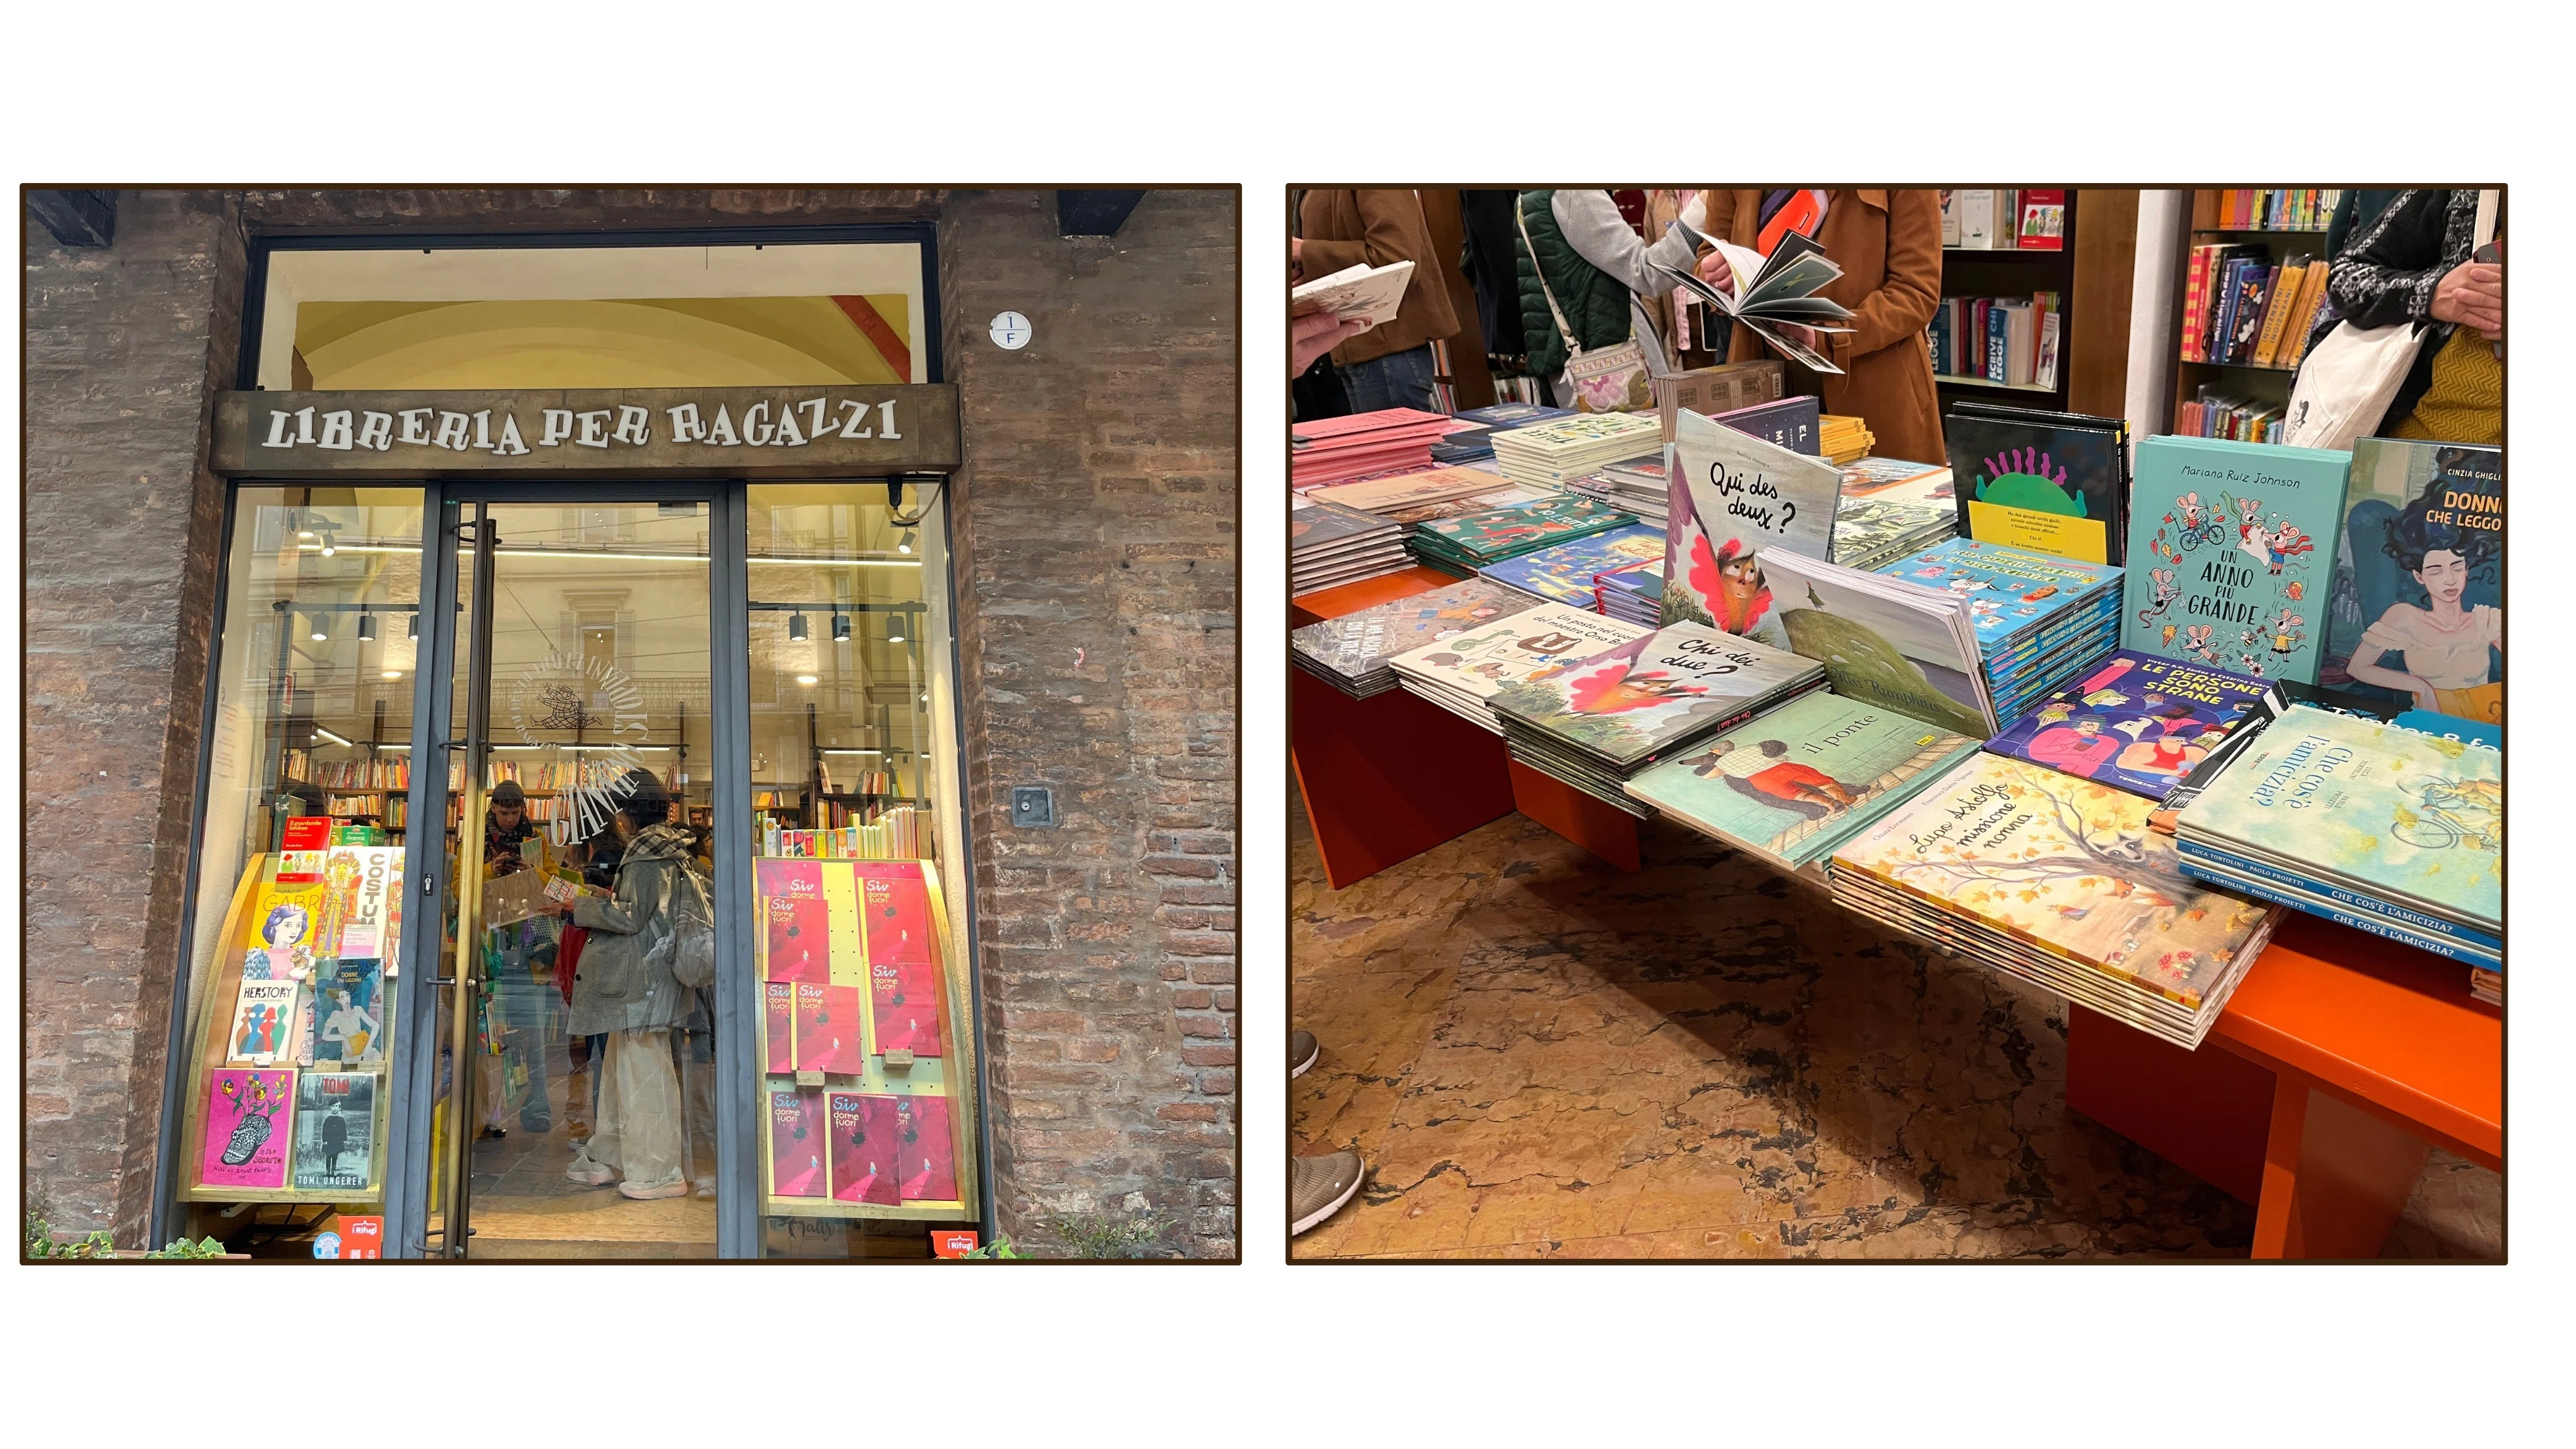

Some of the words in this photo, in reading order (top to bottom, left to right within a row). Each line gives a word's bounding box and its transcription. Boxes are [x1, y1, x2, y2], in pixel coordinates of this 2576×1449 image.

[1989, 309, 1998, 332] CHI
[1007, 333, 1015, 343] F
[1989, 336, 1997, 379] SCRIVE
[261, 405, 530, 456] LIBRERIA
[538, 405, 650, 449] PER
[672, 397, 902, 448] RAGAZZI
[1799, 425, 1807, 442] EL
[1710, 462, 1744, 496] Qui
[1750, 474, 1778, 499] des
[2181, 465, 2222, 479] Mariana
[2253, 473, 2300, 489] Johnson
[2447, 468, 2472, 478] CINZIA
[1728, 496, 1775, 530] deux
[1779, 502, 1796, 534] ?
[2426, 510, 2453, 525] CHE
[2221, 550, 2238, 563] UN
[2200, 561, 2253, 588] ANNO
[2215, 584, 2234, 599] PIÙ
[2188, 595, 2258, 625] GRANDE
[1557, 614, 1571, 622] Un
[1570, 619, 1597, 629] posto
[1547, 620, 1583, 634] maestro
[1585, 631, 1607, 641] Orso
[1678, 639, 1720, 655] Chi
[1725, 652, 1760, 667] dei
[1660, 655, 1708, 671] due
[2142, 664, 2166, 674] LE
[2169, 670, 2263, 696] PERSONE
[2162, 677, 2221, 695] SONO
[2217, 674, 2248, 684] Catarina
[1827, 667, 1863, 688] Miss
[1864, 679, 1940, 712] Rumphius
[2144, 681, 2224, 705] STRANE
[1731, 715, 1740, 724] dei
[1741, 710, 1751, 721] Chi
[1893, 705, 1914, 716] Barbara
[1914, 712, 1936, 723] Cooney
[1720, 719, 1731, 729] due
[1801, 742, 1825, 754] il
[1823, 715, 1878, 747] ponte
[2315, 748, 2353, 773] Che
[2348, 760, 2368, 780] TORTOLINI
[2359, 766, 2373, 777] LUCA
[2323, 790, 2343, 809] PROIETTI
[2335, 796, 2349, 809] PAOLO
[1873, 828, 1891, 842] Chiara
[1889, 812, 1914, 830] Lorenzoni
[1921, 789, 1945, 806] Francesca
[1909, 821, 1953, 854] Lupo
[1944, 782, 2010, 820] Astolfo
[1957, 802, 2017, 847] missione
[1983, 813, 2033, 850] nonna
[2191, 847, 2208, 857] LUCA
[2209, 854, 2245, 869] TORTOLINI
[2250, 866, 2271, 876] PAOLO
[2272, 872, 2304, 886] PROIETTI
[790, 880, 814, 891] Siv
[866, 880, 889, 891] Siv
[2193, 869, 2210, 880] LUCA
[2212, 876, 2246, 891] TORTOLINI
[2251, 888, 2273, 900] PAOLO
[2274, 895, 2306, 910] PROIETTI
[771, 899, 794, 910] Siv
[2331, 890, 2352, 903] CHE
[2356, 897, 2385, 911] COS'È
[2387, 905, 2453, 933] L'AMICIZIA?
[2333, 914, 2354, 926] CHE
[2357, 920, 2387, 936] COS'È
[2389, 930, 2455, 957] L'AMICIZIA?
[873, 965, 897, 977] Siv
[244, 986, 294, 999] HERSTORY
[799, 985, 823, 997] Siv
[876, 982, 895, 991] fuori
[801, 1002, 821, 1010] fuori
[323, 1078, 350, 1094] TOMI
[774, 1094, 799, 1107] Siv
[833, 1097, 859, 1111] Siv
[775, 1109, 800, 1117] dorme
[777, 1114, 797, 1124] fuori
[833, 1111, 859, 1120] dorme
[835, 1118, 856, 1127] fuori
[299, 1176, 319, 1185] TOMI
[324, 1176, 362, 1186] UNGERER
[355, 1226, 377, 1235] Rifugi
[951, 1241, 974, 1251] Rifugi
